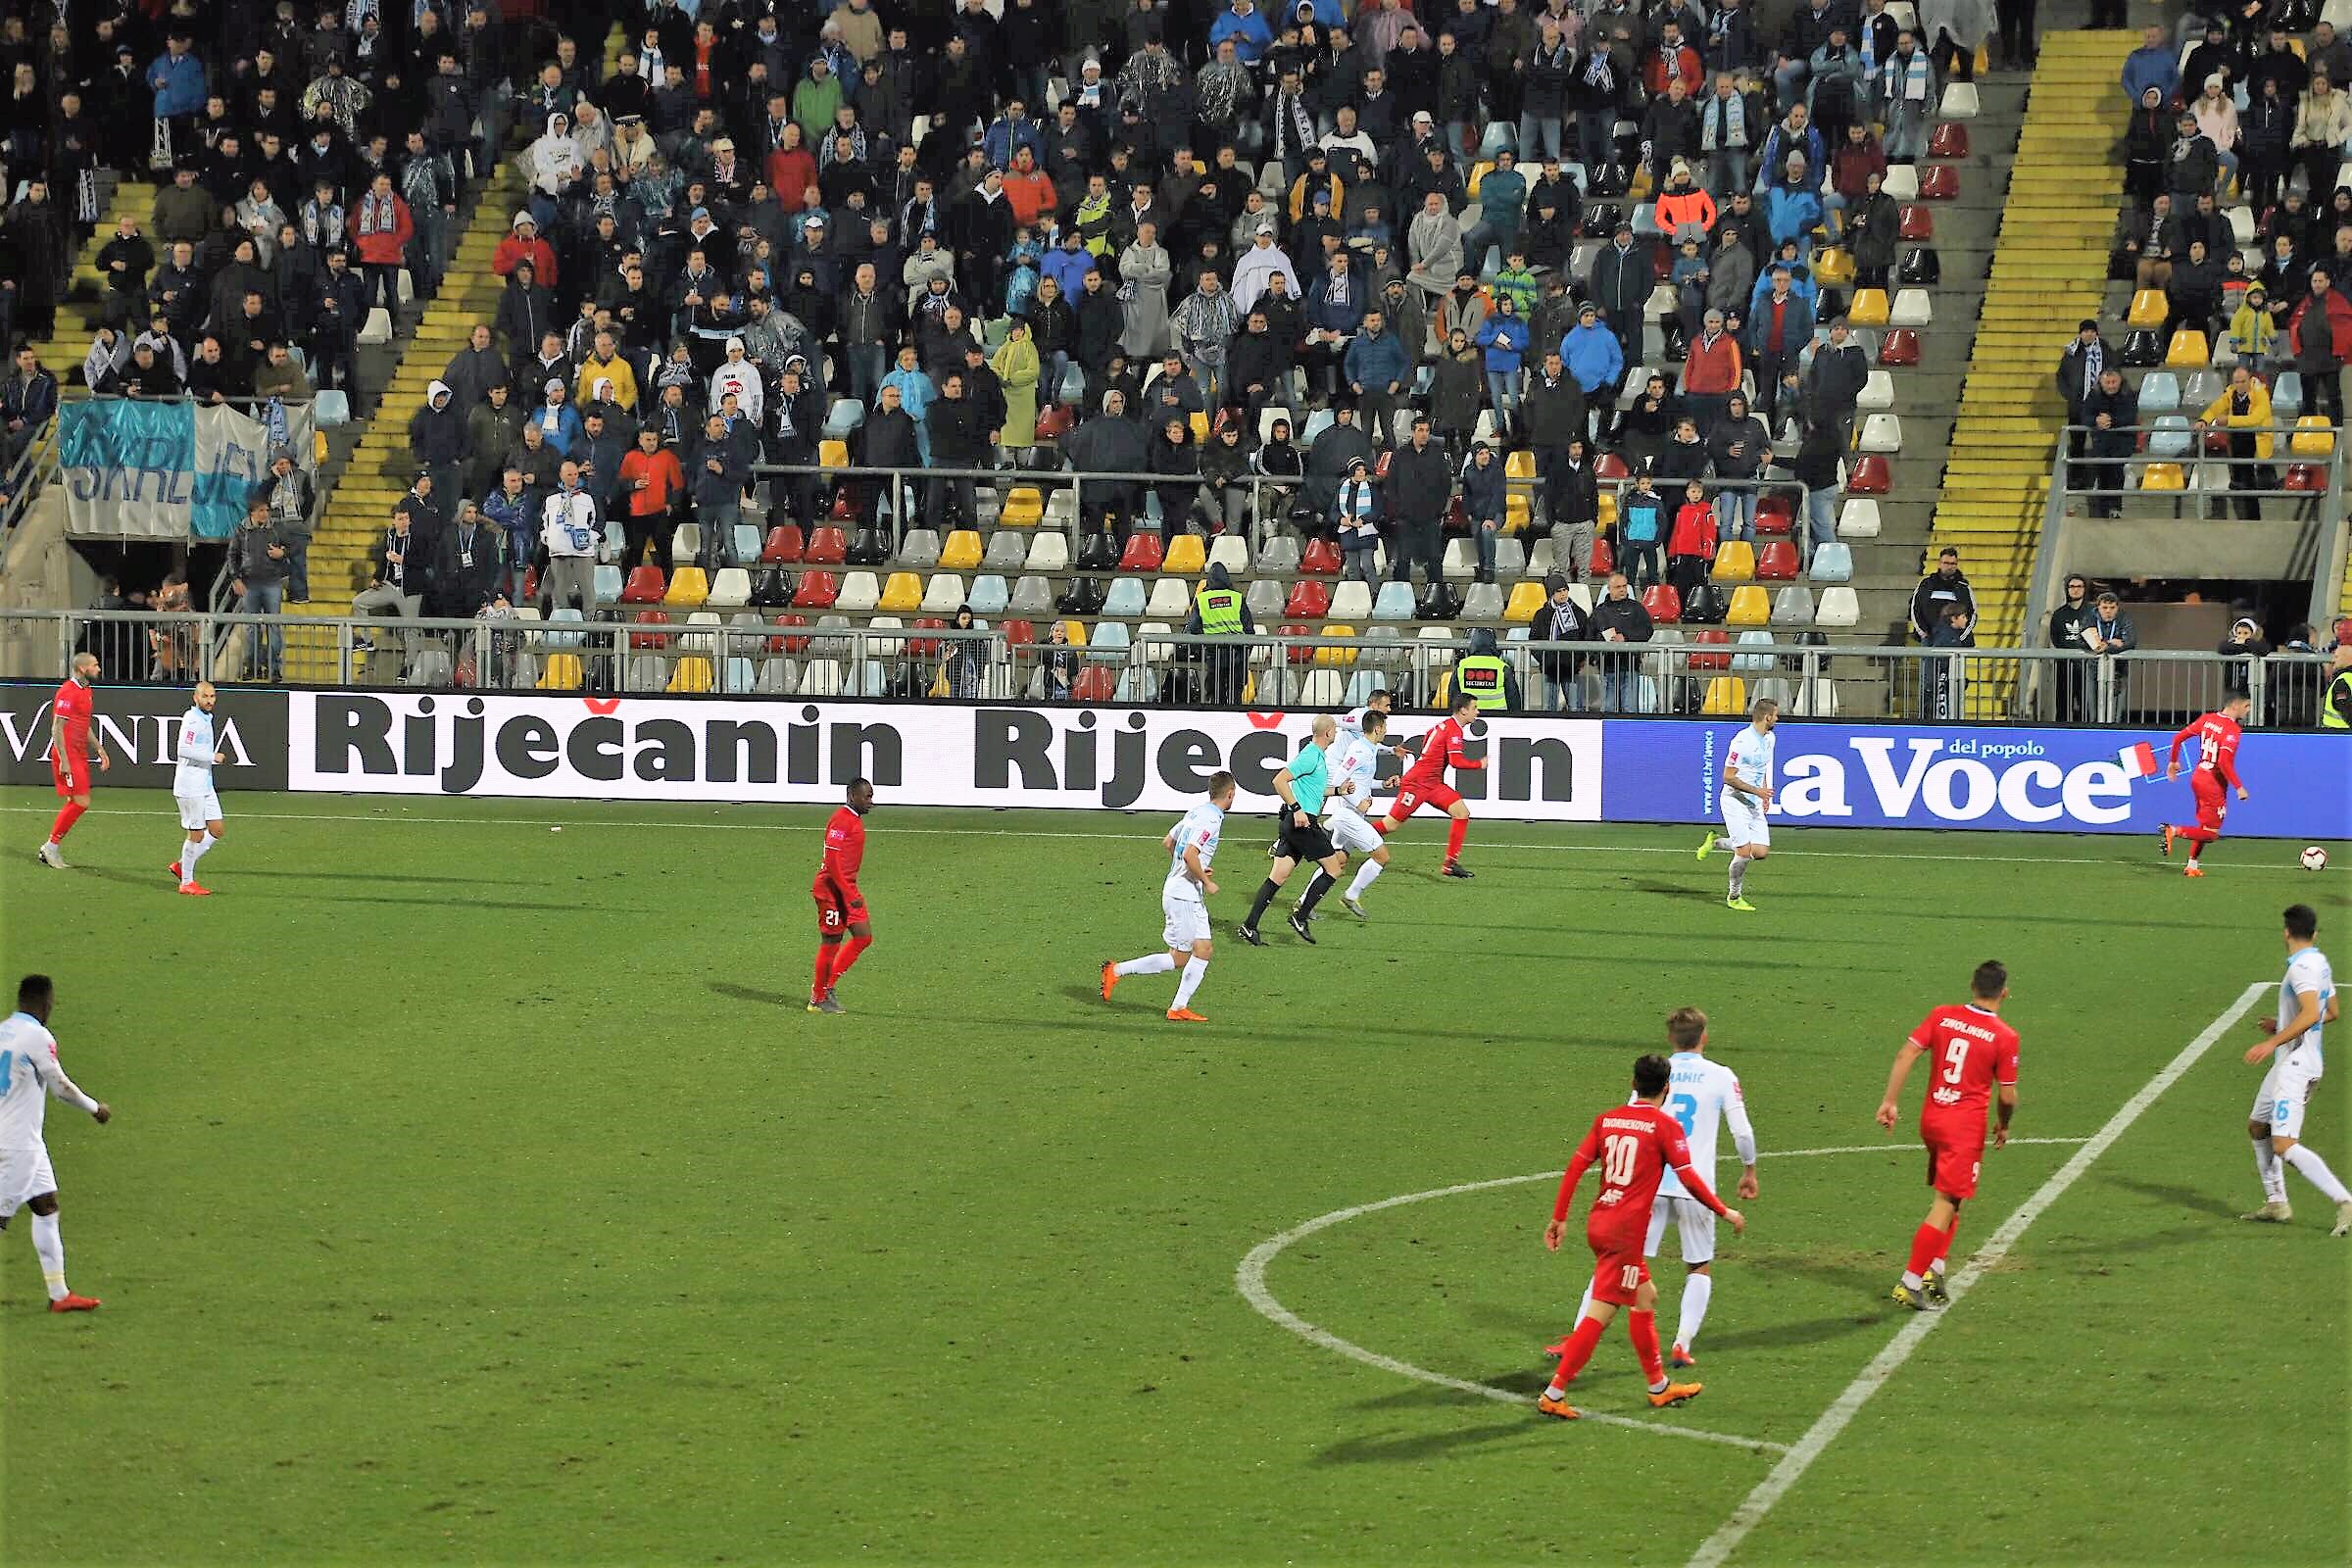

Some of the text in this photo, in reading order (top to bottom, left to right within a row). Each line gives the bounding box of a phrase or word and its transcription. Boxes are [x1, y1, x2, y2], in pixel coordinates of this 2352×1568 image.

[315, 695, 903, 794] Riječanin
[974, 709, 1573, 808] Riječin
[1949, 739, 2045, 758] del popolo
[2200, 731, 2219, 763] 44
[1850, 737, 2132, 824] Voce
[825, 909, 840, 926] 21
[1942, 1037, 1970, 1084] 9
[1672, 1093, 1697, 1138] 3
[2276, 1099, 2289, 1121] 6
[1604, 1134, 1639, 1187] 10
[1621, 1264, 1640, 1290] 10
